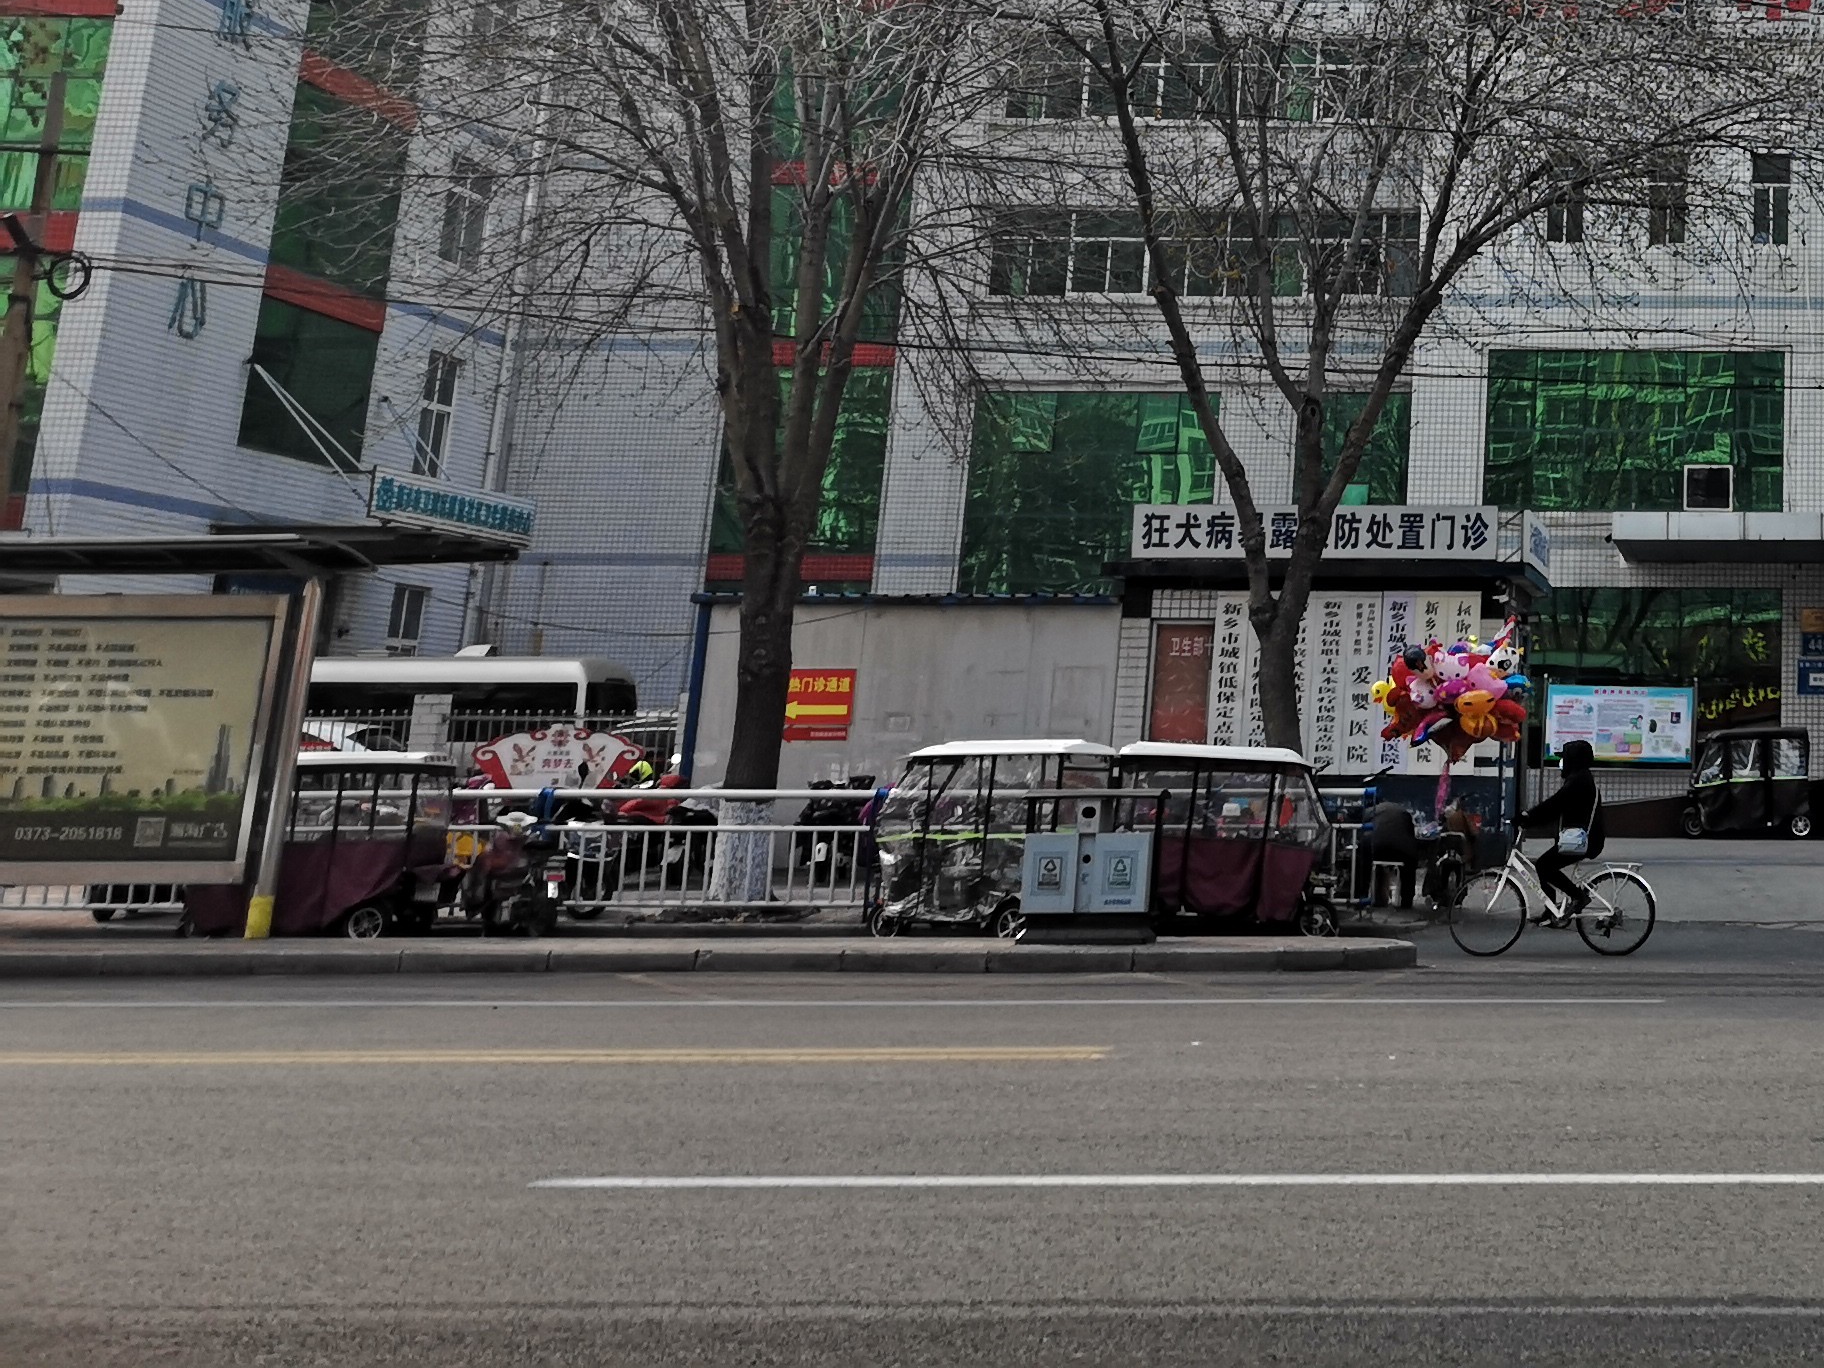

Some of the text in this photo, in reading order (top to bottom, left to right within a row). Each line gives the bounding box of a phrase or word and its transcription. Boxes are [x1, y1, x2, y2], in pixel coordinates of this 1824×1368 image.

[1141, 511, 1491, 552] 狂犬病露防处置门诊
